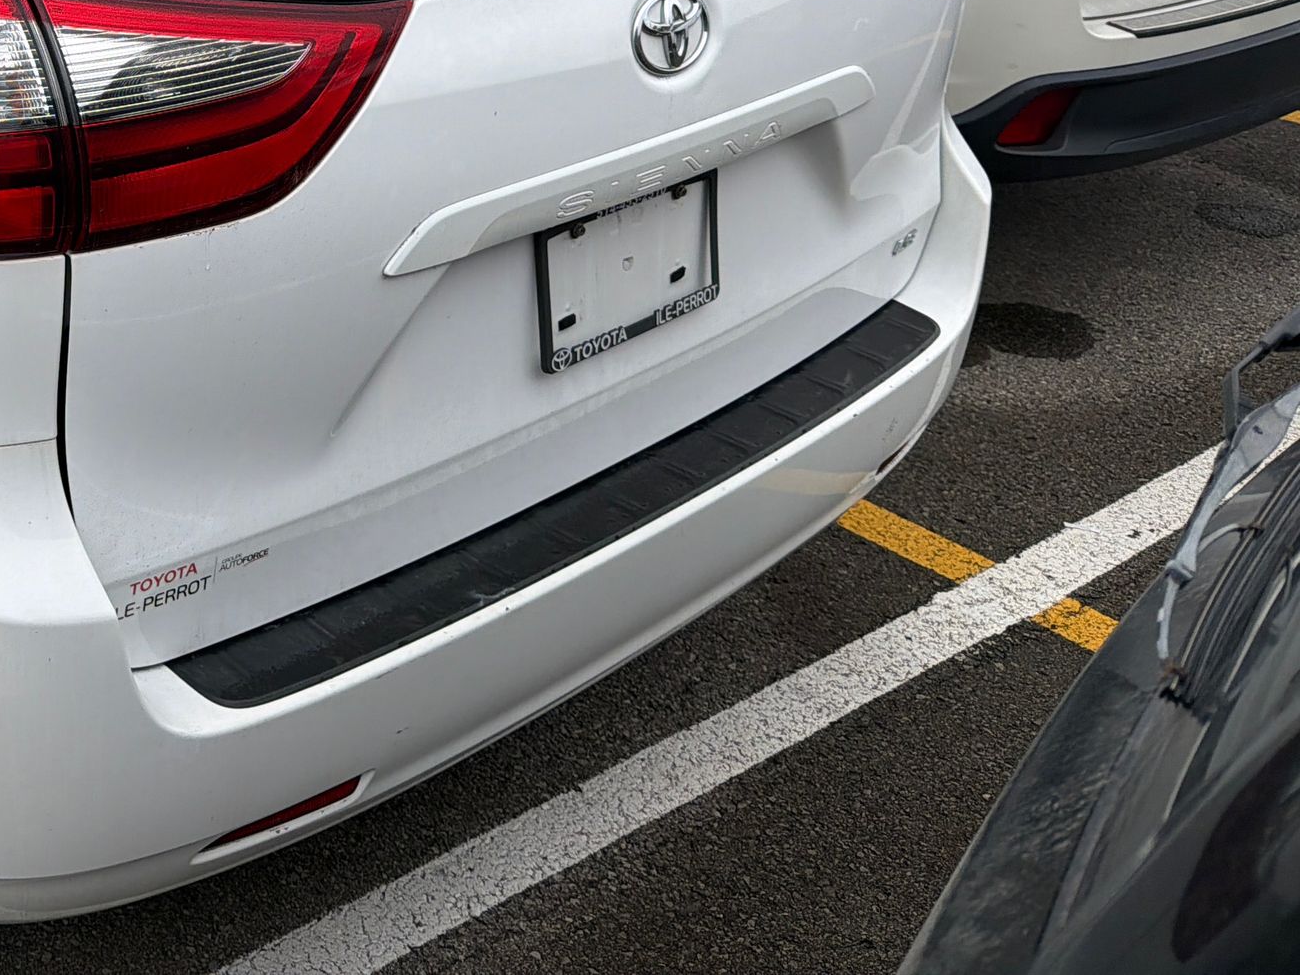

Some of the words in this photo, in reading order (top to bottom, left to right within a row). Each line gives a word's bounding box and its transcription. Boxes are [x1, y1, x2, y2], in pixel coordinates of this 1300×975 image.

[573, 328, 628, 362] TOYOTA
[218, 547, 269, 572] AUTOFORCE
[129, 562, 198, 596] TOYOTA
[115, 575, 212, 620] LE-PERROT
